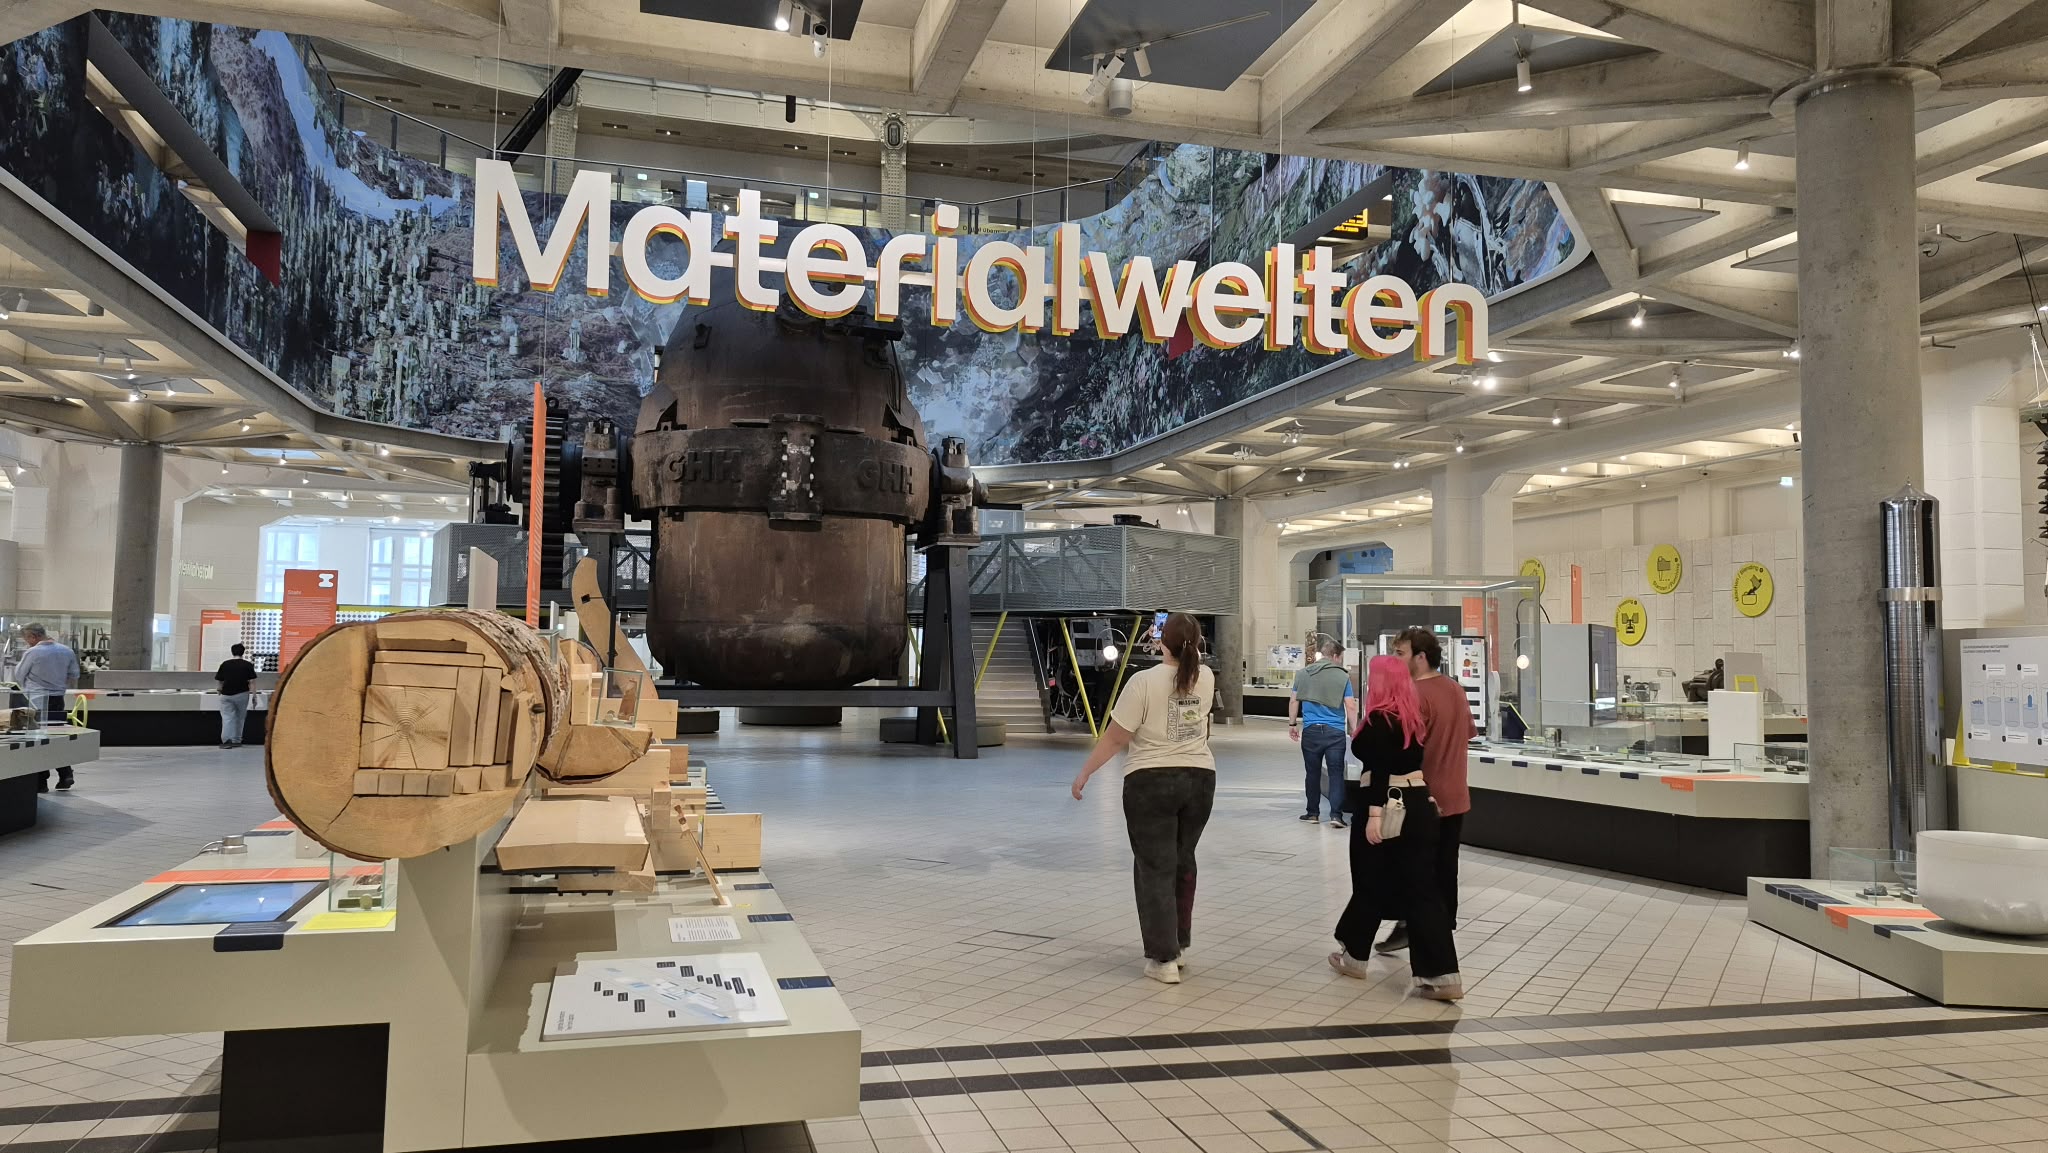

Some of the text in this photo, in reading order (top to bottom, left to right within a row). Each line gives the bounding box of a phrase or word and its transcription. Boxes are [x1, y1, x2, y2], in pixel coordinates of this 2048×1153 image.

[472, 158, 1490, 364] Materialwelten
[663, 448, 743, 483] GHH
[857, 457, 915, 494] GHH
